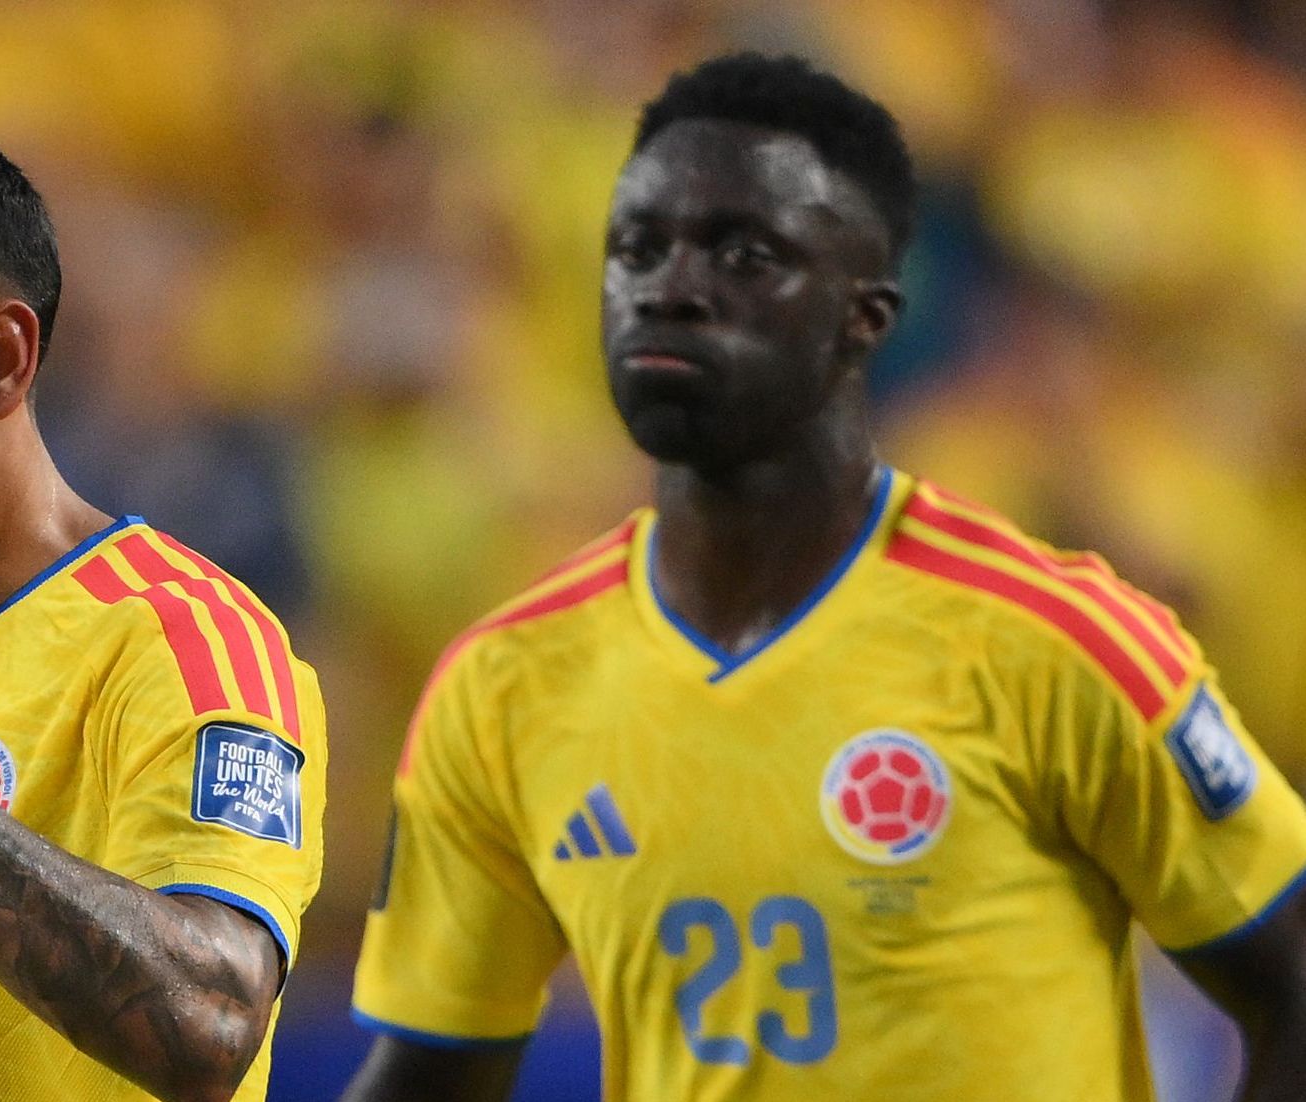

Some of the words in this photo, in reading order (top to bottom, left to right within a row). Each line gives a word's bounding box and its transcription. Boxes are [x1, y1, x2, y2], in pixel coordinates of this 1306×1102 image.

[216, 759, 284, 799] UNITES
[218, 741, 285, 779] FOOTBALL
[210, 782, 241, 796] the
[243, 783, 286, 820] World
[233, 801, 263, 822] FIFA
[658, 895, 837, 1065] 23
